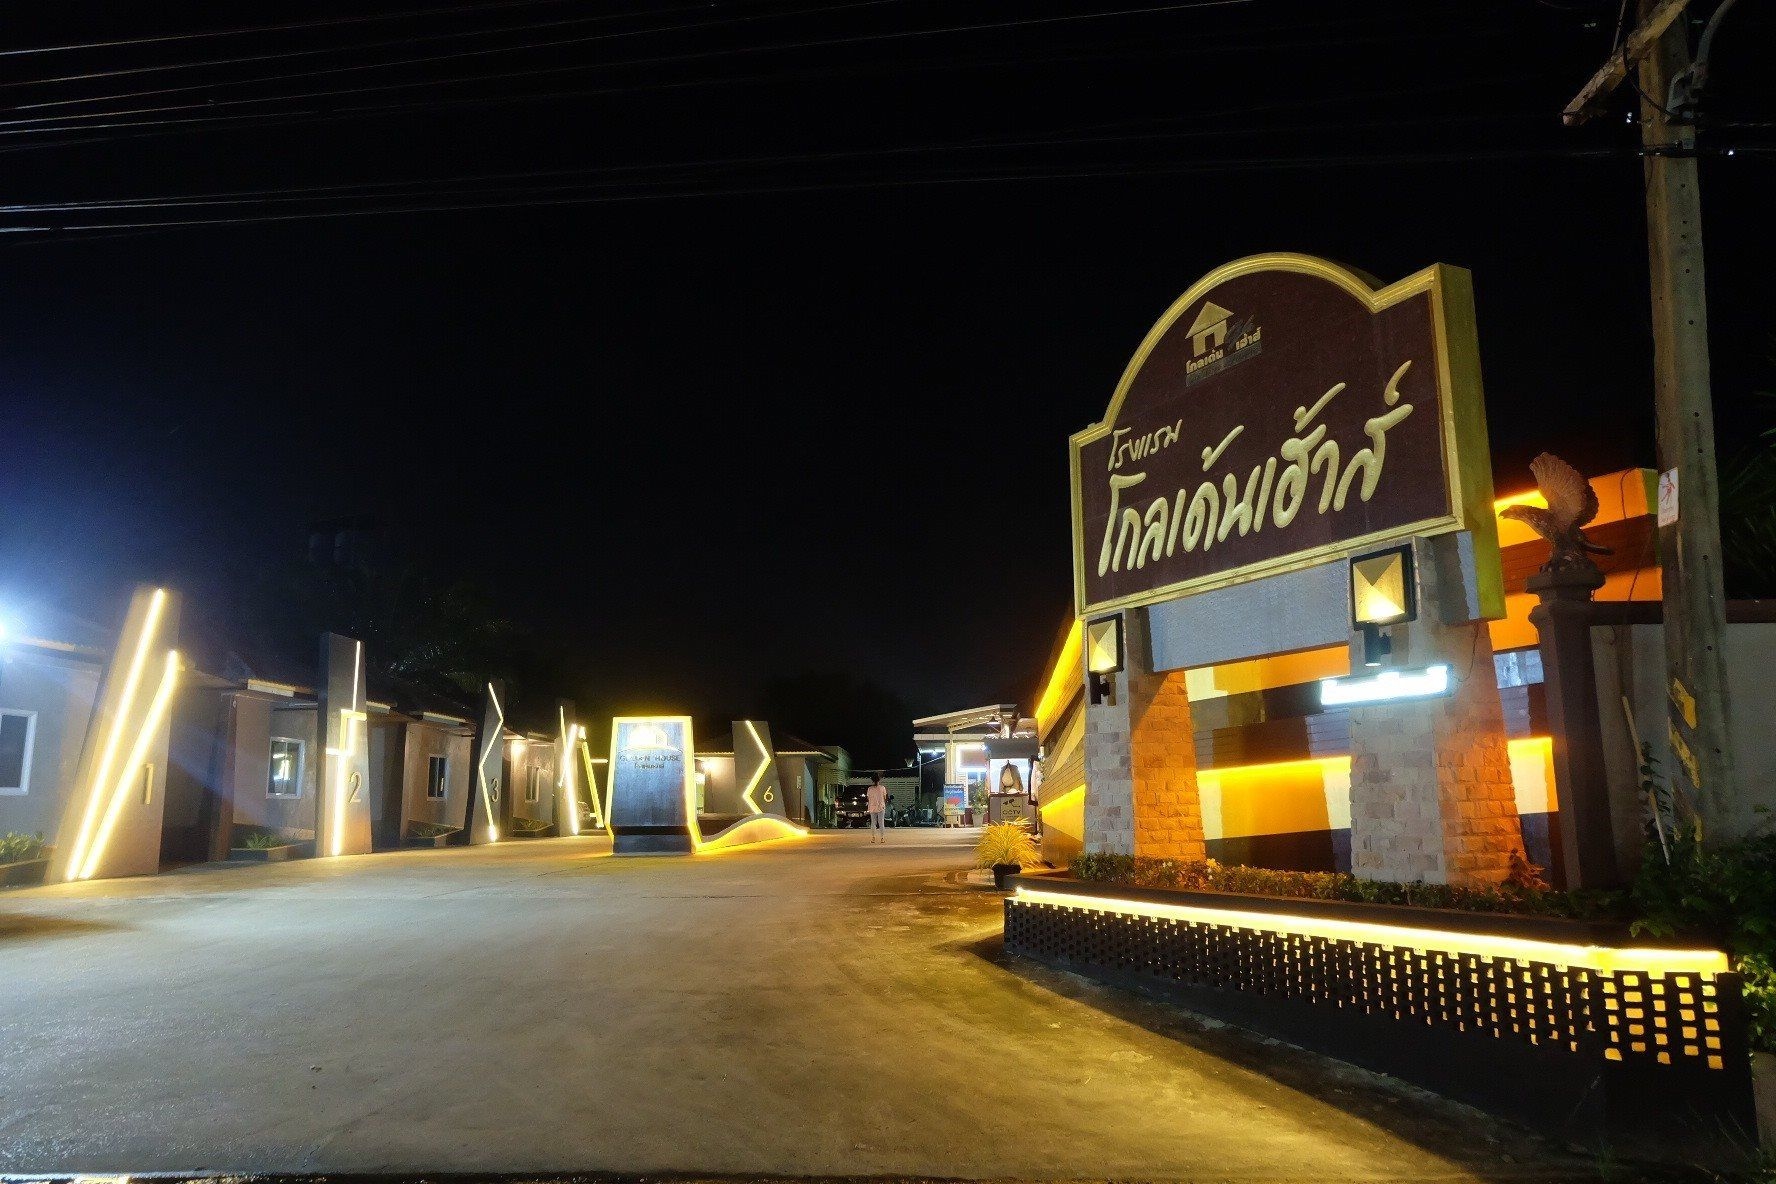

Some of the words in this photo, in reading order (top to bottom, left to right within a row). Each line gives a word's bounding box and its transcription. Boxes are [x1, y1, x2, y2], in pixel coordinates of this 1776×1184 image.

[1108, 419, 1183, 472] โรงแรม
[1098, 360, 1414, 577] โกลเด้นเฮ้าส์
[146, 763, 154, 804] 1
[348, 772, 361, 803] 2
[491, 778, 500, 802] 3
[763, 787, 775, 803] 6
